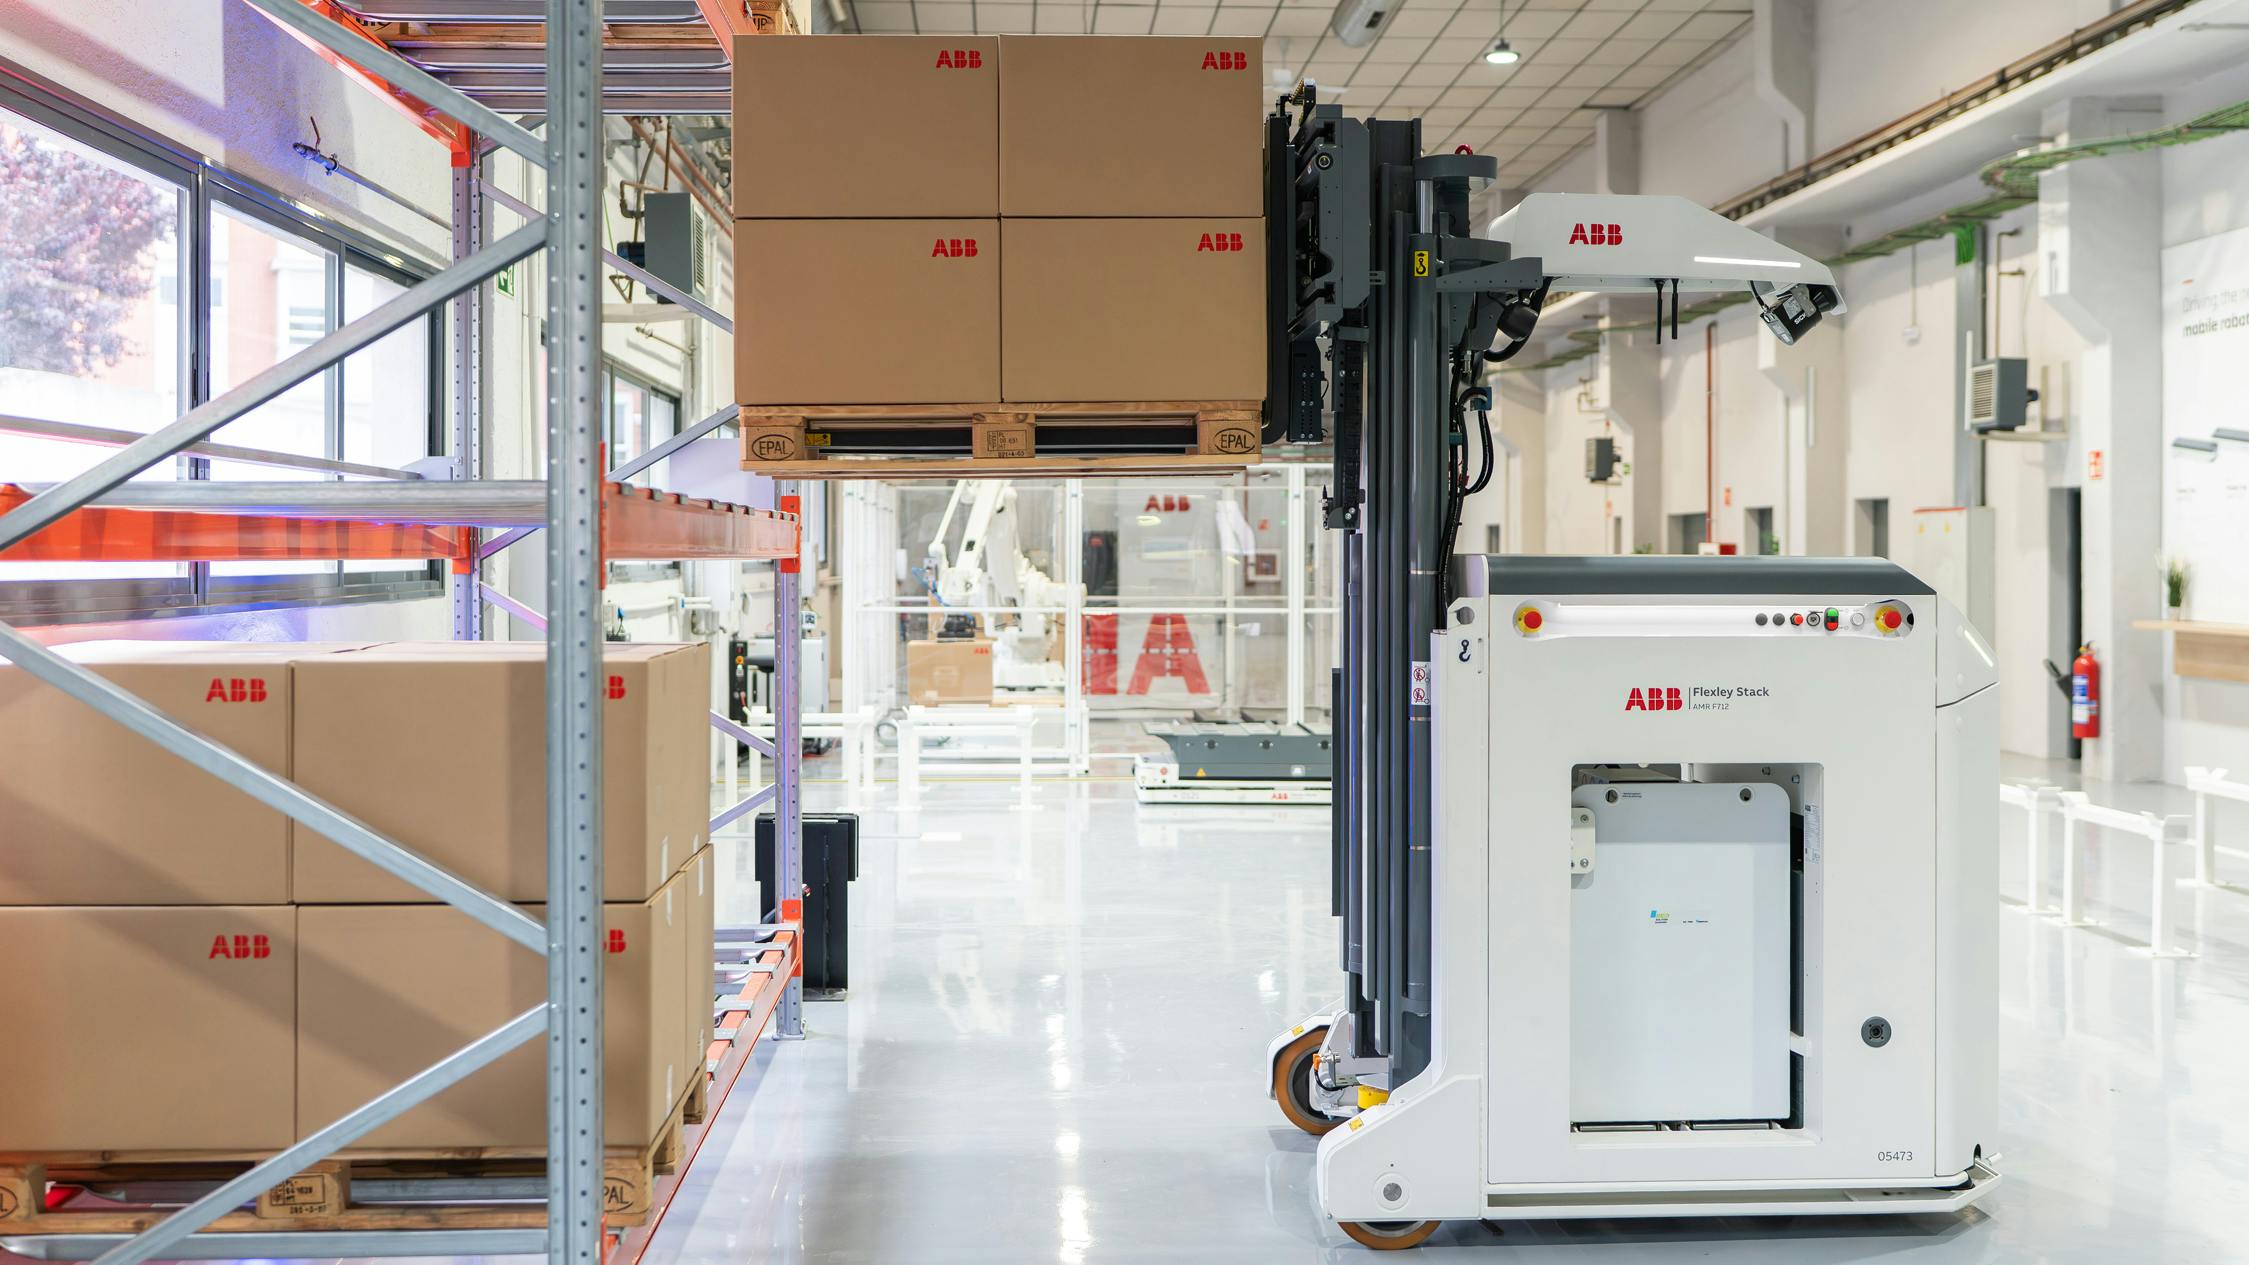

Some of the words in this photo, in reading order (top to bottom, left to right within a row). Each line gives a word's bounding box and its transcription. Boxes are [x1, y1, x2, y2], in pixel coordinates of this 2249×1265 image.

[935, 51, 982, 69] ABB
[1201, 51, 1248, 70] ABB
[1197, 233, 1244, 252] ABB
[1569, 224, 1623, 246] ABB
[932, 239, 978, 257] ABB
[2183, 317, 2218, 337] mobile
[759, 440, 789, 456] EPAL
[1220, 434, 1251, 449] EPAL
[1144, 495, 1191, 513] ABB
[206, 678, 267, 702] ABB
[1625, 688, 1684, 711] ABB
[1693, 687, 1734, 699] Flexley
[1736, 687, 1770, 697] Stack
[209, 935, 271, 959] ABB
[1877, 1151, 1913, 1161] 05473
